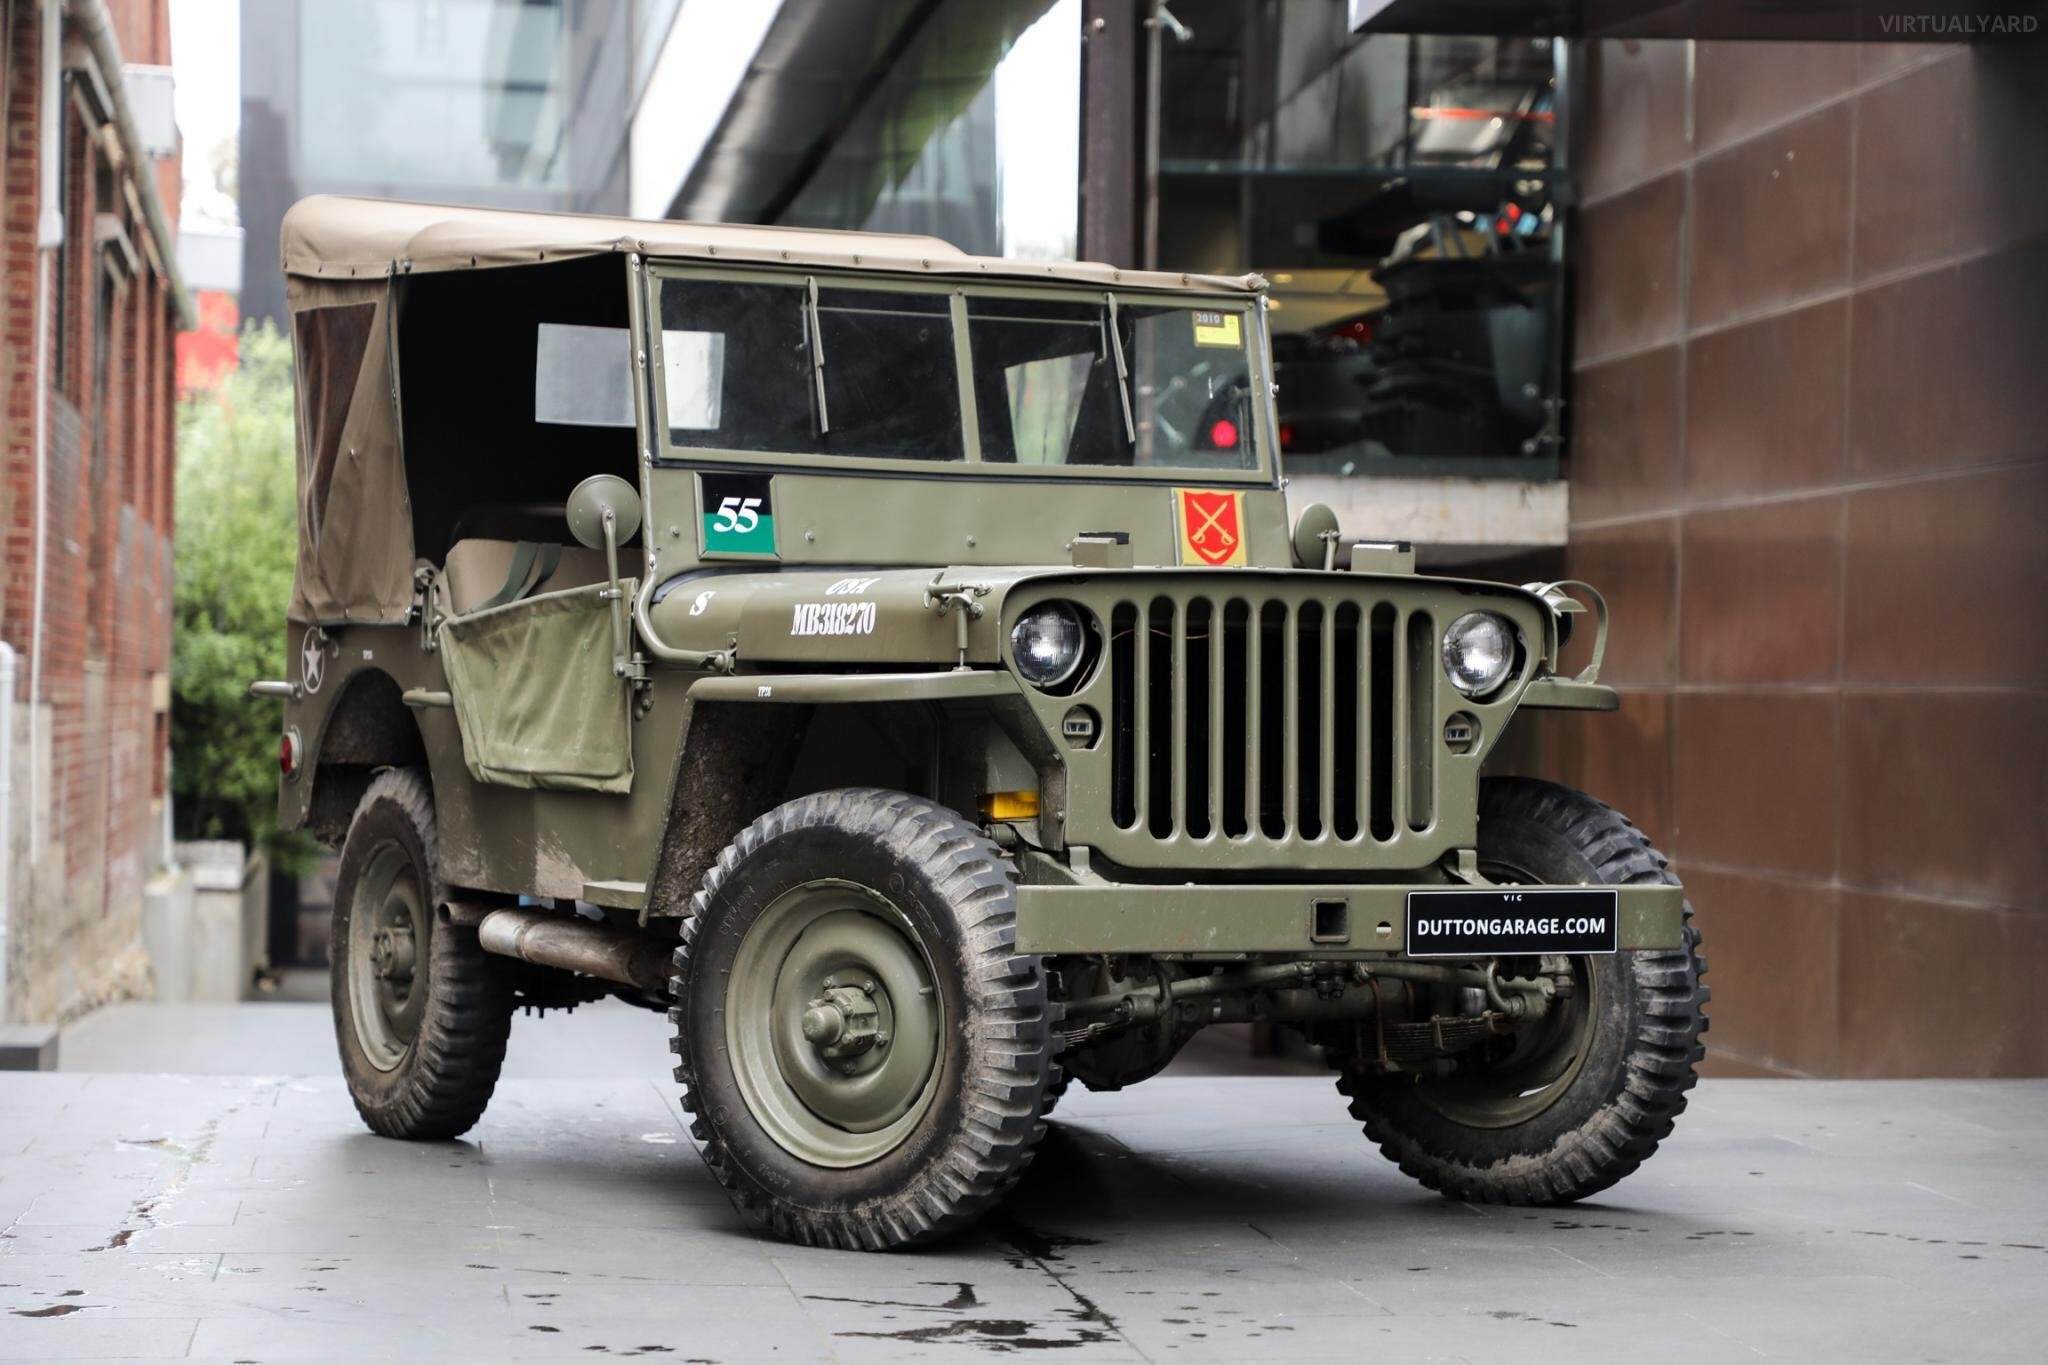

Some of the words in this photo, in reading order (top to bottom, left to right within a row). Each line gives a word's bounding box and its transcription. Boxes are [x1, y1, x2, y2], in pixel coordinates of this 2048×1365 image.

[713, 496, 762, 534] 55
[689, 591, 717, 616] S
[790, 602, 876, 635] MB318270
[1503, 894, 1522, 902] VIC
[1417, 917, 1606, 936] DUTTONGARAGE.COM
